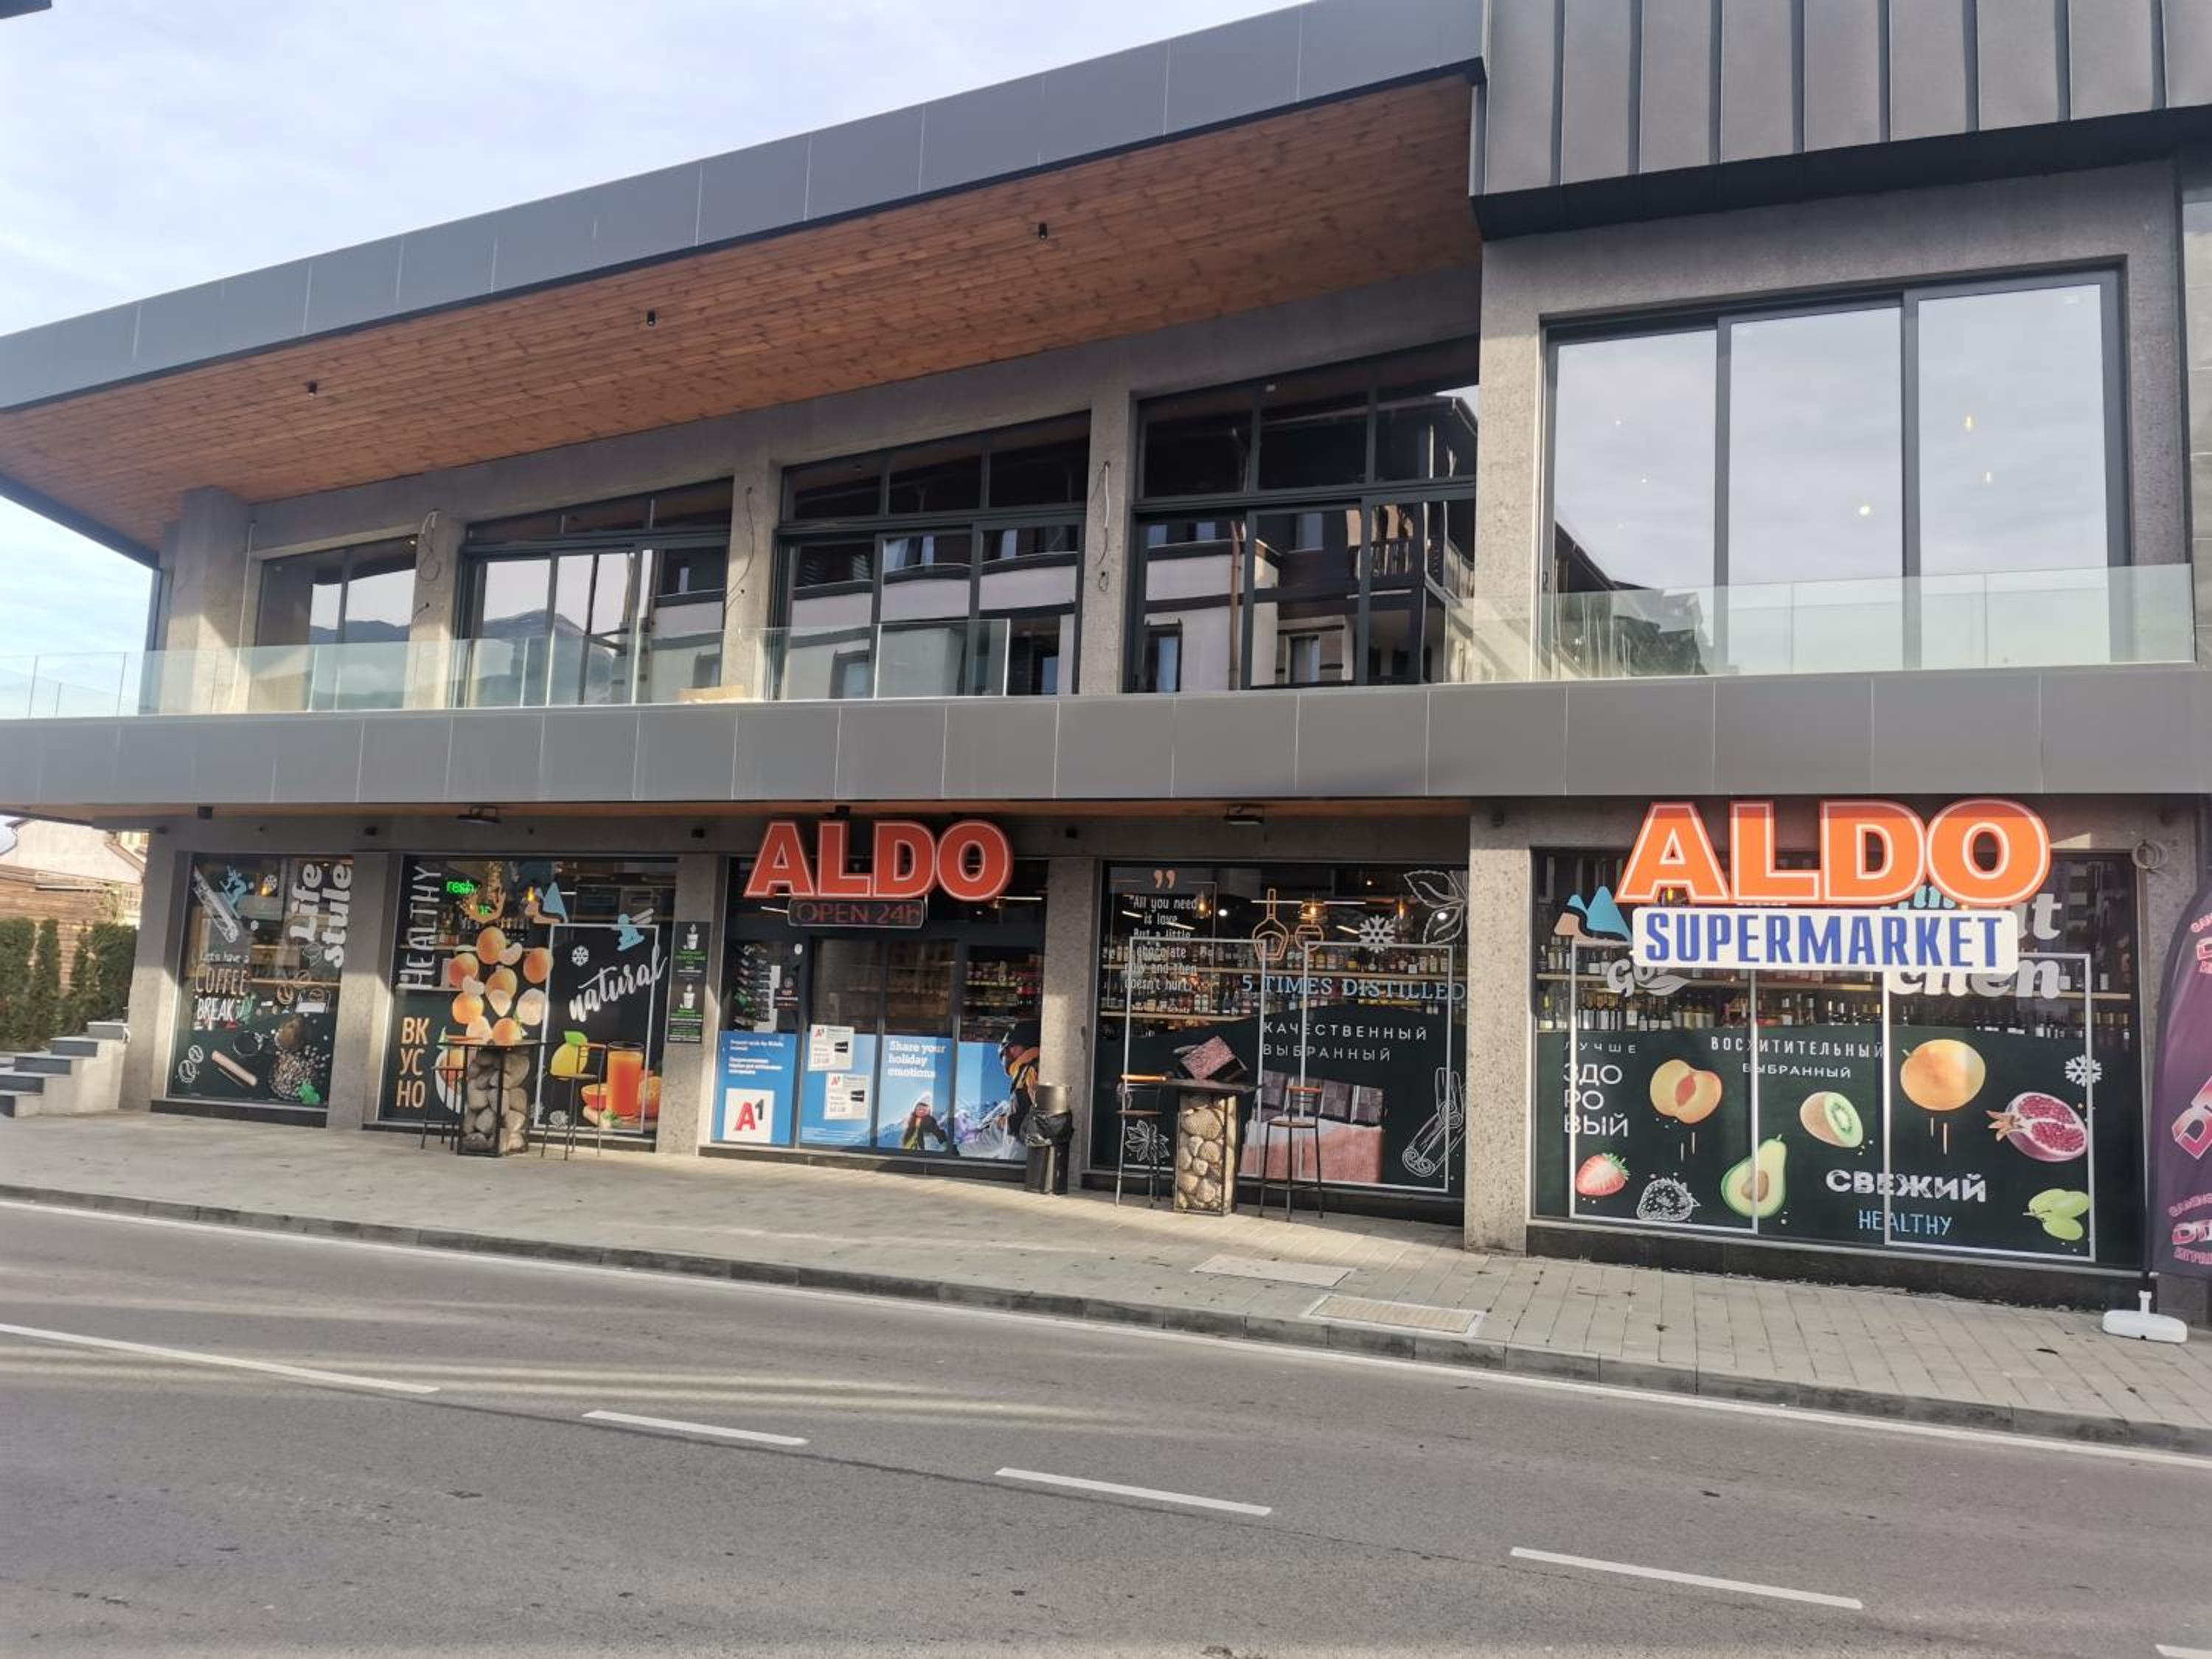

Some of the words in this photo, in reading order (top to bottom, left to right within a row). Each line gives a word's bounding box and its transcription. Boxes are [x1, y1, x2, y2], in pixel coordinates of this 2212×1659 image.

[743, 819, 1015, 902] ALDO
[1615, 798, 2051, 907] ALDO
[290, 863, 322, 942] Life
[796, 902, 869, 924] OPEN
[1151, 897, 1169, 913] you
[1173, 897, 1197, 910] need
[397, 865, 442, 990] HEALTHY
[1144, 911, 1152, 925] is
[1644, 912, 2003, 968] SUPERMARKET
[195, 964, 248, 995] COFFEE
[568, 944, 668, 1023] natural
[1242, 975, 1253, 992] 5
[1263, 976, 1333, 995] TIMES
[1341, 979, 1466, 1001] DISTILLED
[197, 997, 236, 1023] BREAK
[400, 1017, 430, 1046] ВК
[1263, 1021, 1428, 1041] КАЧЕСТВЕННЫЙ
[888, 1053, 928, 1067] holiday
[889, 1040, 920, 1051] Share
[921, 1045, 947, 1055] your
[1262, 1043, 1391, 1062] ВЫБРАННЫЙ
[398, 1048, 425, 1076] УС
[887, 1067, 936, 1079] emotions
[395, 1079, 426, 1107] НО
[734, 1099, 765, 1132] A1
[1826, 1169, 1986, 1203] СВЕЖИЙ
[1858, 1209, 1953, 1237] HEALTHY
